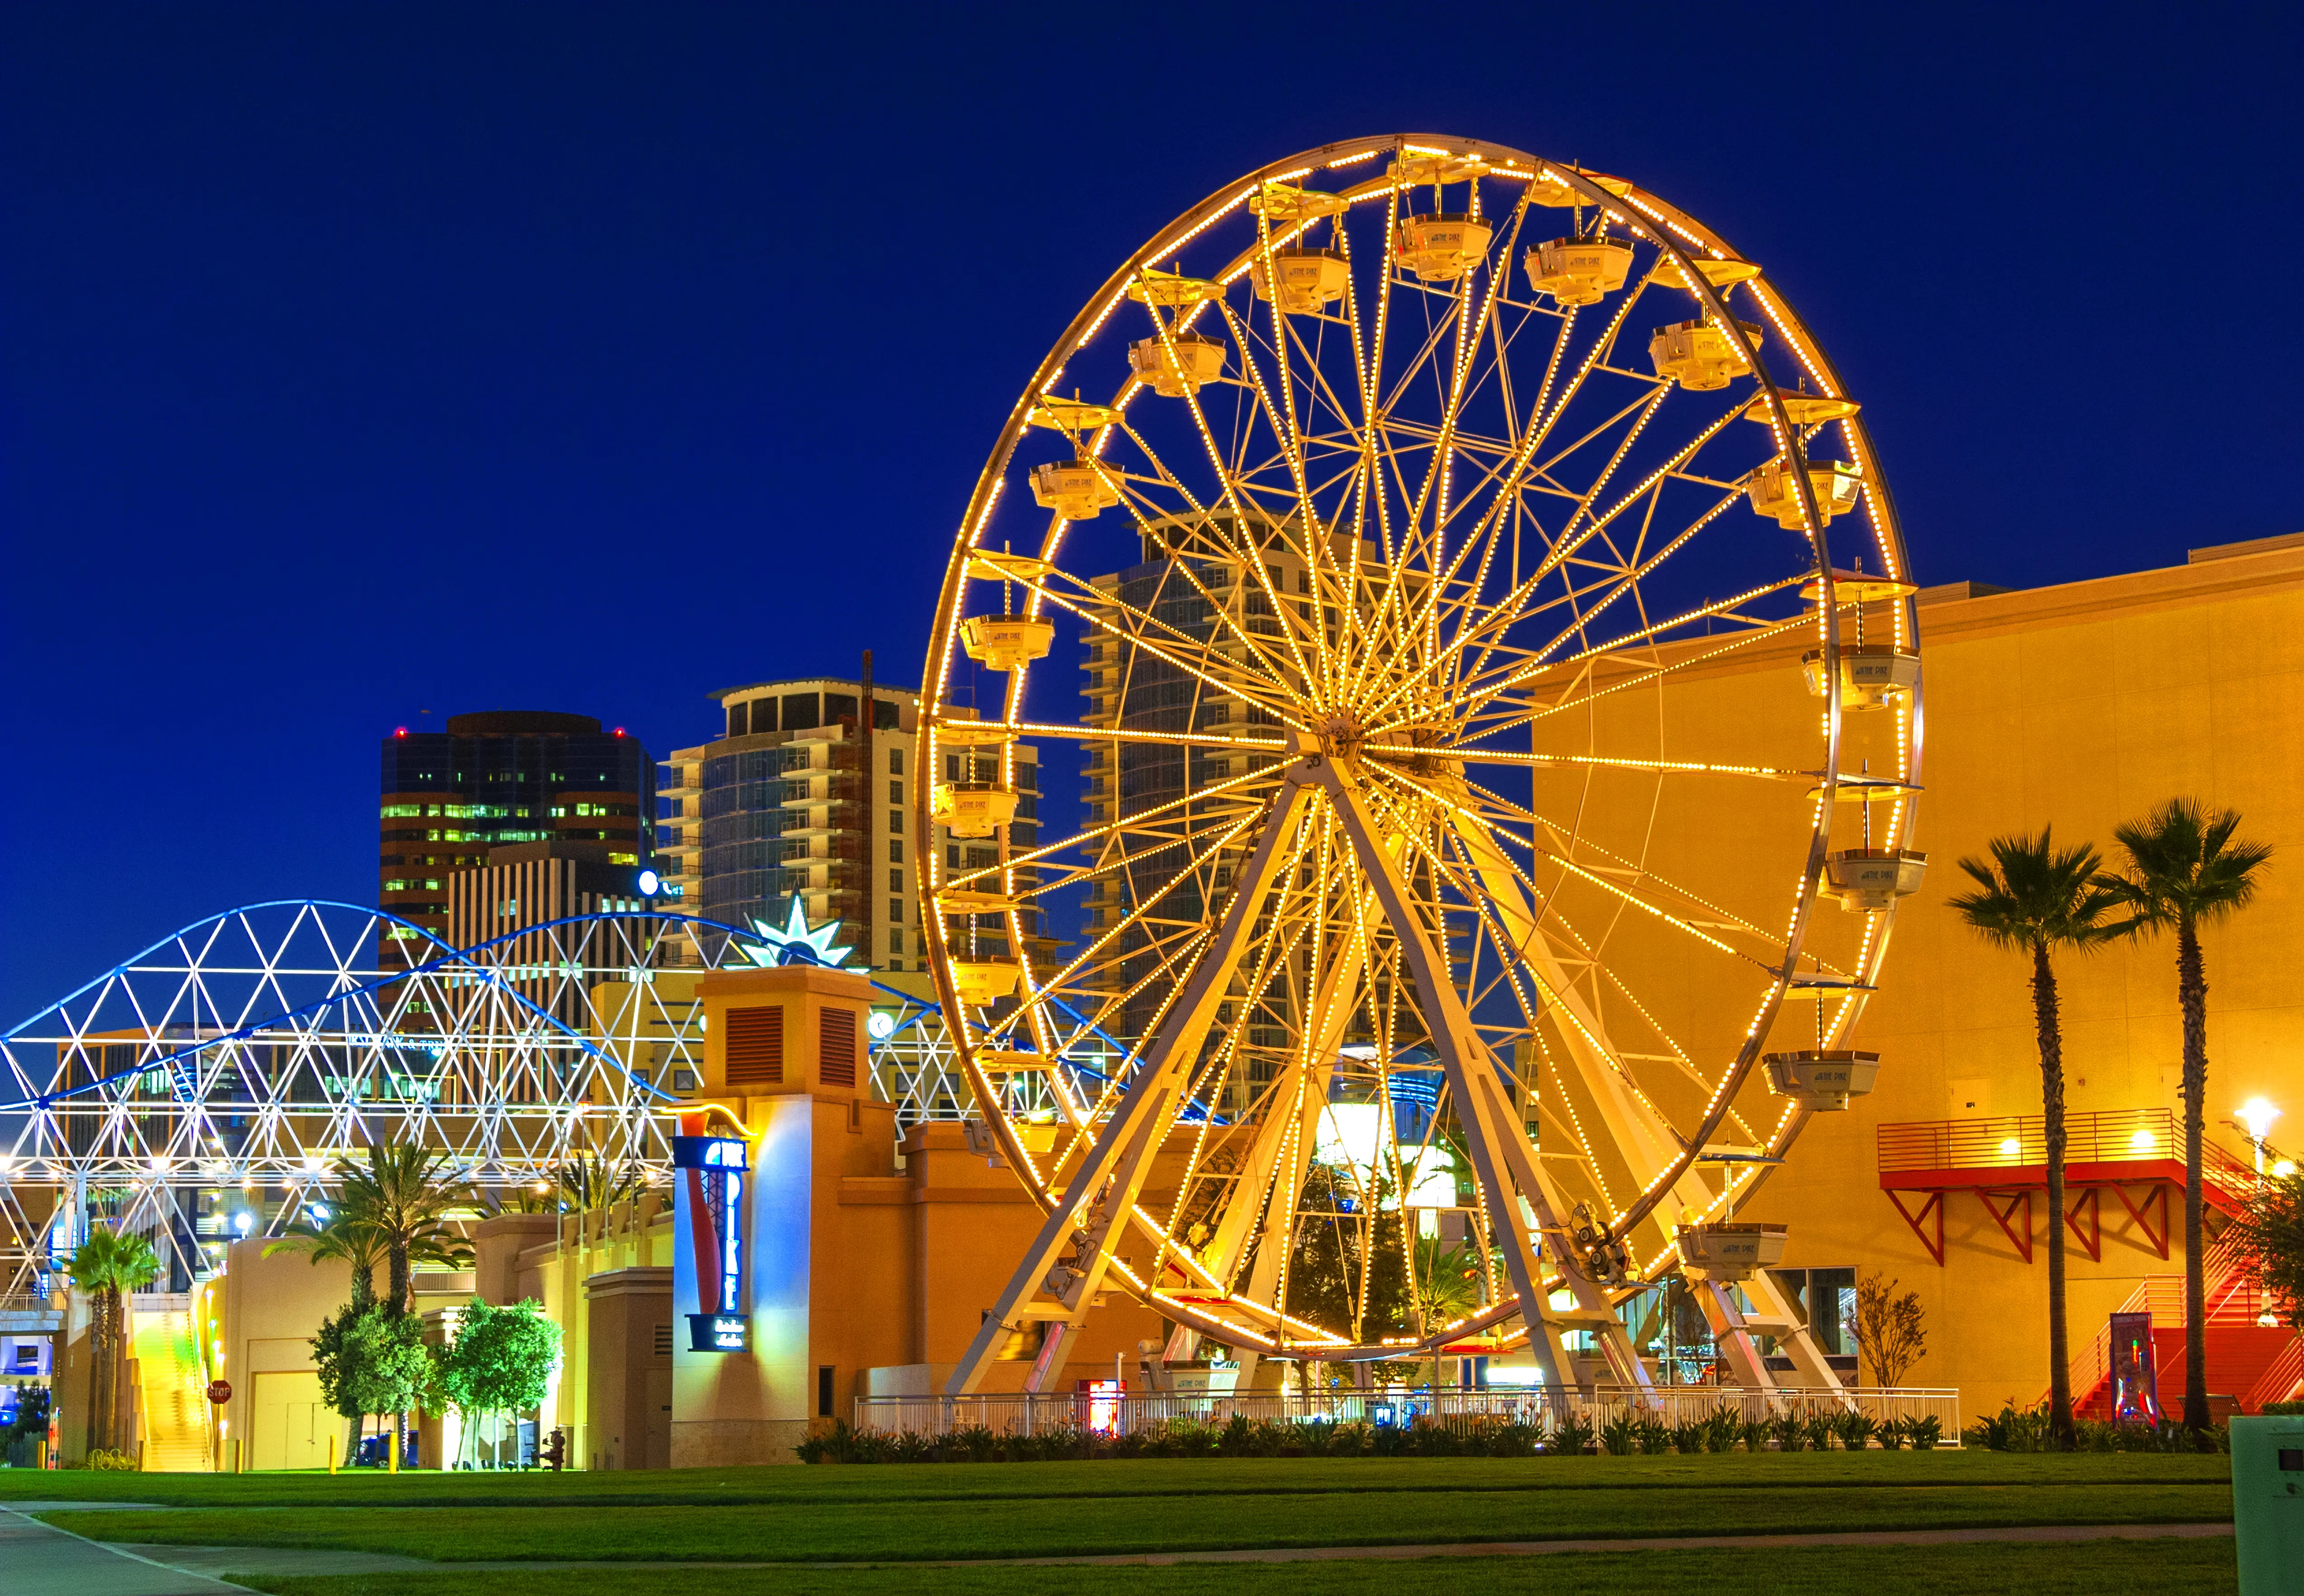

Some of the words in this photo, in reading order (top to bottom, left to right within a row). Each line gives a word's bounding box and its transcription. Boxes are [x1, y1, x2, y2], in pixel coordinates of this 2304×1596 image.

[1589, 257, 1599, 265] PIKE
[1876, 666, 1888, 674] PIKE
[1881, 871, 1893, 879] PIKE
[1834, 1072, 1846, 1081] PIKE
[725, 1172, 740, 1310] PIKE
[1742, 1244, 1754, 1253] PIKE
[209, 1387, 230, 1396] STOP
